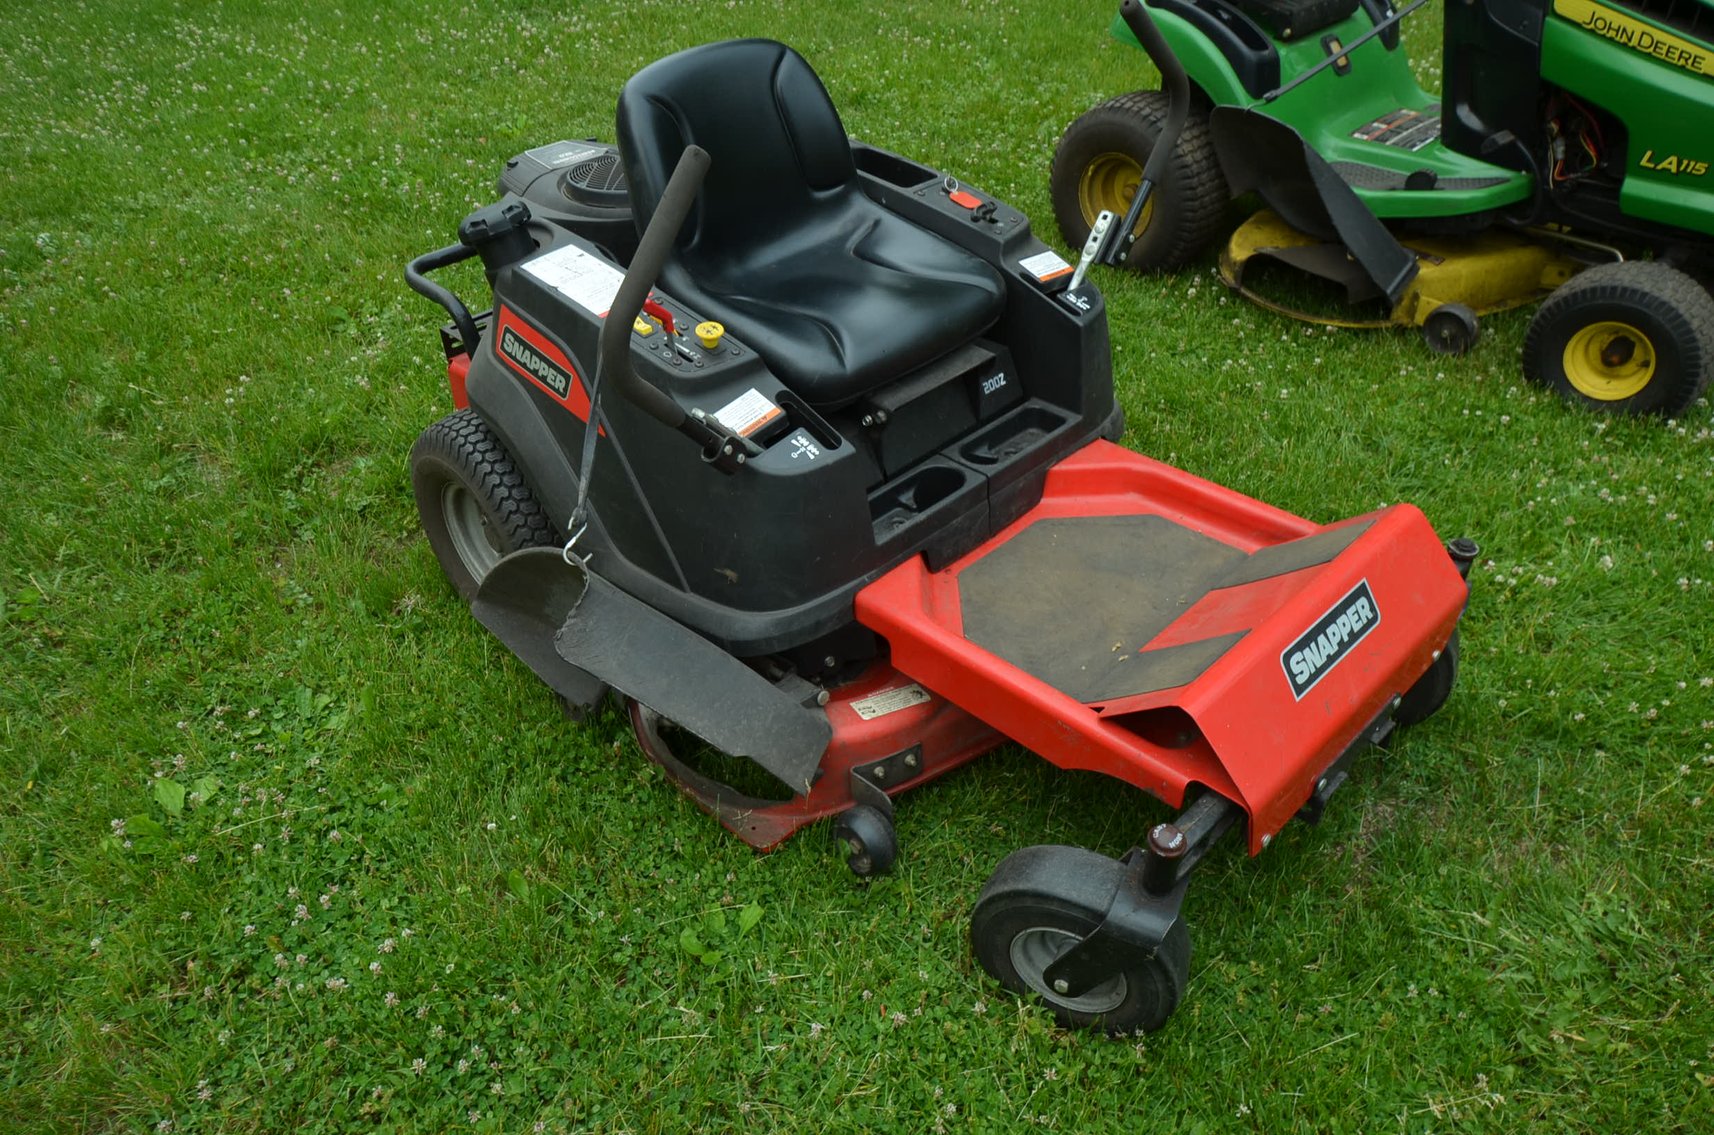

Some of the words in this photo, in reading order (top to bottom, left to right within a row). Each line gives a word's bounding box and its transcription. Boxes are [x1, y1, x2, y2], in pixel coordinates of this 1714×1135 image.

[1582, 10, 1635, 46] JOHN
[1637, 30, 1706, 73] DEERE
[1640, 150, 1709, 176] LA115
[503, 332, 567, 394] SNAPPER
[1289, 596, 1374, 685] SNAPPER
